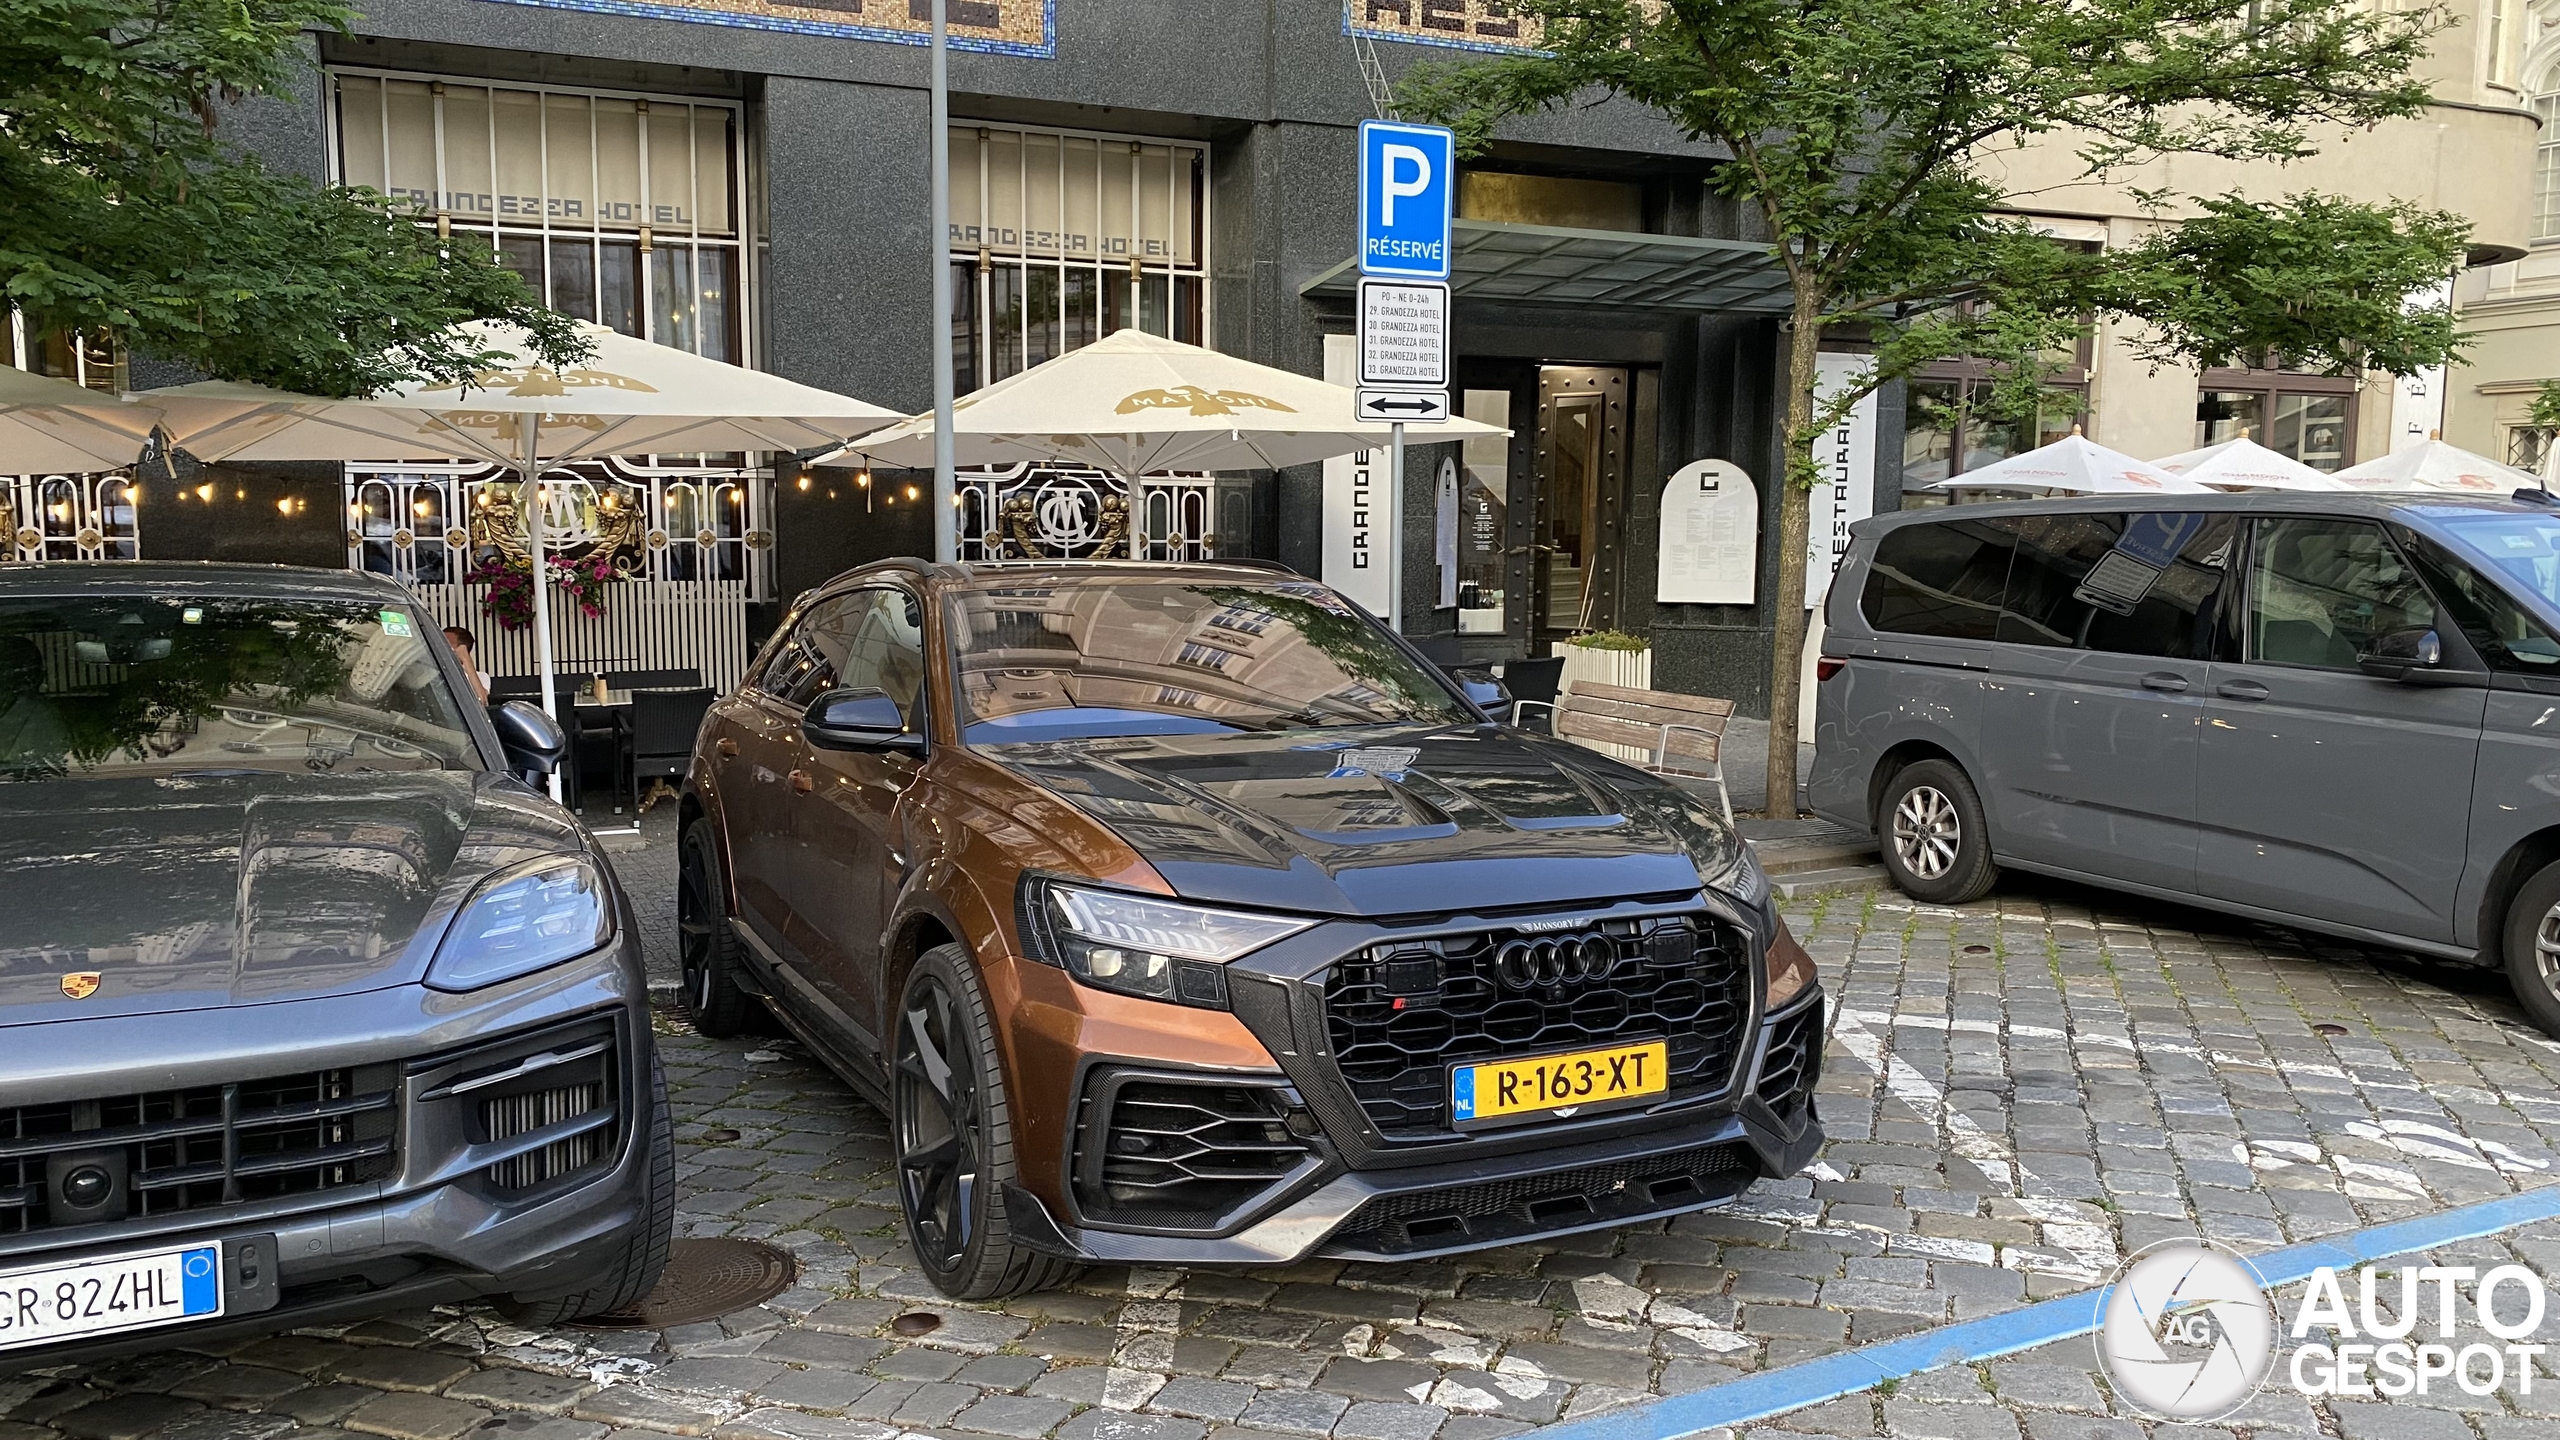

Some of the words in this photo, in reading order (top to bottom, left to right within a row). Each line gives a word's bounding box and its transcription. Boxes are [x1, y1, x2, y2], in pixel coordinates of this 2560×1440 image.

[1382, 143, 1431, 227] P
[1368, 235, 1442, 260] RÉSERVÉ
[1381, 291, 1391, 302] PO
[1398, 293, 1407, 303] NE
[1369, 305, 1379, 316] 29.
[1381, 306, 1418, 318] GRANDEZZA
[1420, 309, 1440, 320] HOTEL
[1368, 320, 1378, 331] 30.
[1381, 321, 1418, 333] GRANDEZZA
[1420, 323, 1440, 334] HOTEL
[1368, 335, 1378, 345] 31.
[1380, 335, 1417, 347] GRANDEZZA
[1419, 338, 1439, 349] HOTEL
[1368, 349, 1378, 360] 32.
[1380, 350, 1417, 362] GRANDEZZA
[1419, 352, 1440, 363] HOTEL
[1367, 364, 1378, 375] 33.
[1380, 365, 1417, 376] GRANDEZZA
[1419, 367, 1439, 377] HOTEL
[1131, 392, 1269, 407] MATTONI
[1533, 918, 1574, 931] MANSORY
[1498, 1052, 1649, 1107] R-163-XT
[1457, 1098, 1472, 1111] NL
[56, 1268, 179, 1320] 824HL
